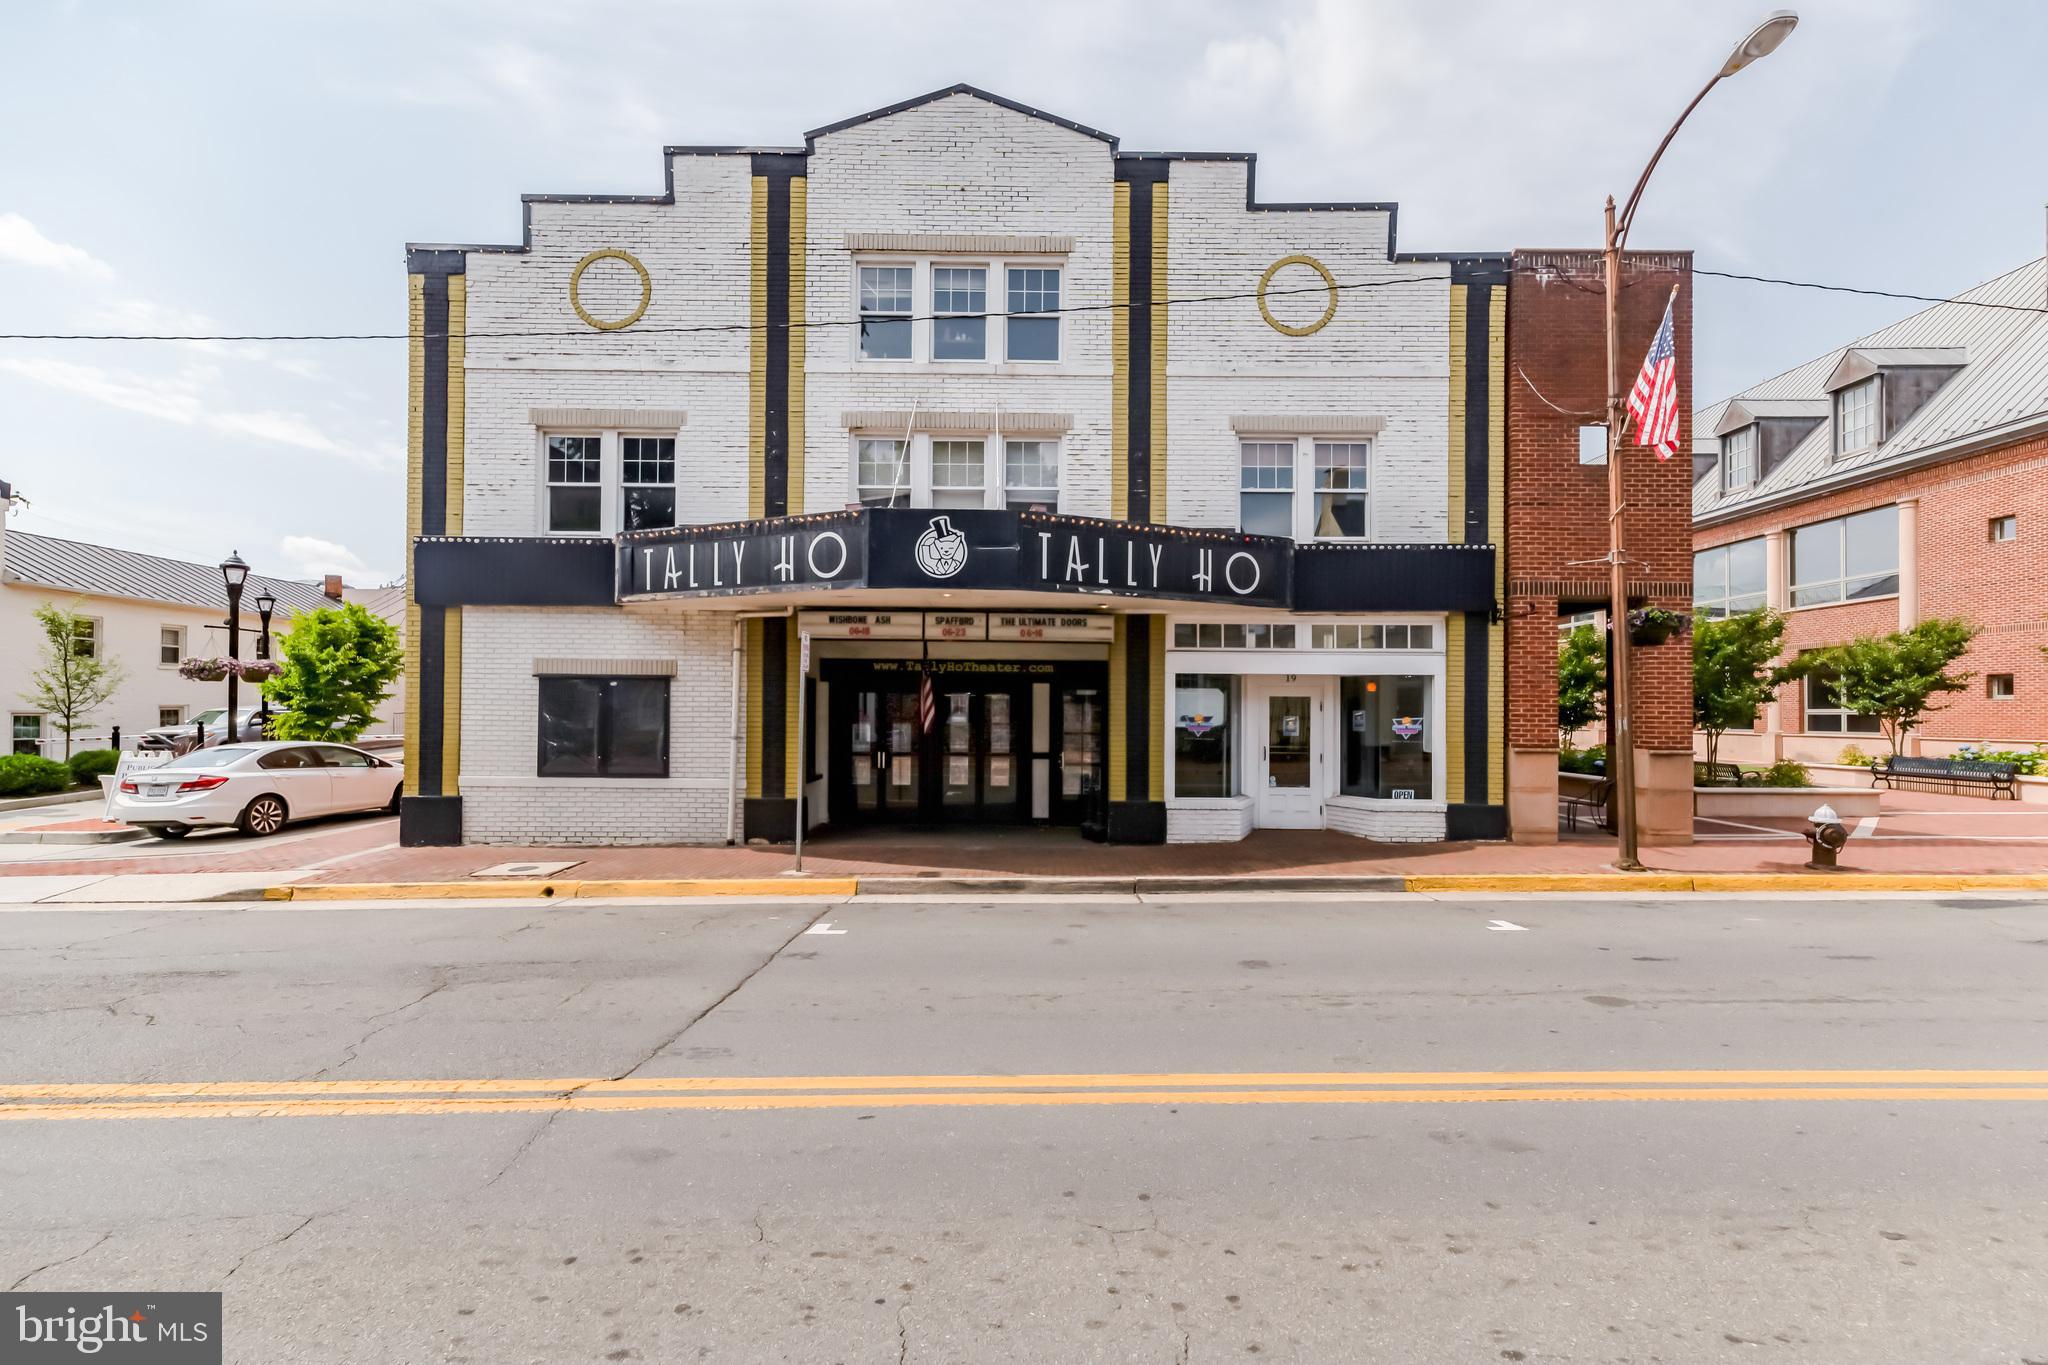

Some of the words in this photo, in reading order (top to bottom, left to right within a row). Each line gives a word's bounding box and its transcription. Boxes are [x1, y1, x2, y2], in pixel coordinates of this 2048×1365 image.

[643, 540, 746, 591] TALLY
[774, 531, 847, 582] HO
[1038, 532, 1163, 588] TALLY
[1192, 548, 1260, 595] HO
[828, 615, 868, 625] WISHBONE
[874, 615, 891, 625] ASH
[935, 616, 975, 626] SPAFFORD
[1001, 617, 1016, 626] THE
[1018, 617, 1056, 627] ULTIMATE
[1060, 618, 1088, 628] DOORS
[873, 661, 1054, 674] www.TalyHoTheater.com
[1285, 674, 1297, 683] 19
[1393, 790, 1413, 800] OPEN
